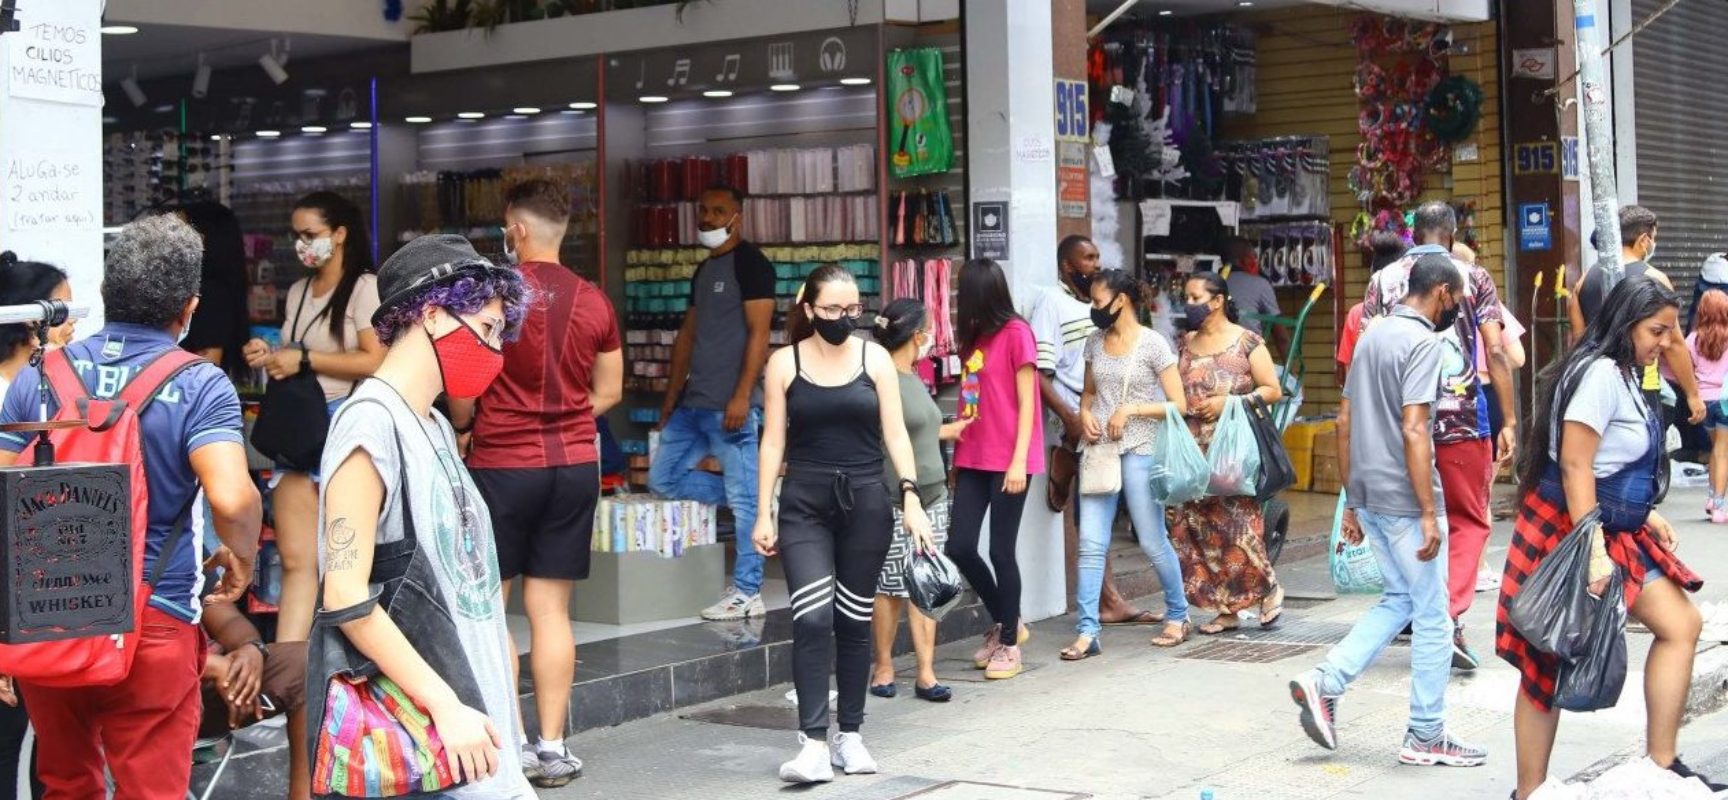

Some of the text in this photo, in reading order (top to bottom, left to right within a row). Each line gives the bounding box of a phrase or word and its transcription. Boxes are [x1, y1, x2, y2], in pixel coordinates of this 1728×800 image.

[29, 22, 86, 44] TEMOS
[26, 45, 73, 65] CILIOS
[12, 66, 102, 92] MAGNETICOS
[1056, 81, 1086, 137] 915
[1517, 145, 1554, 171] 915
[11, 184, 79, 202] 2 andar
[29, 593, 115, 613] WHISKEY
